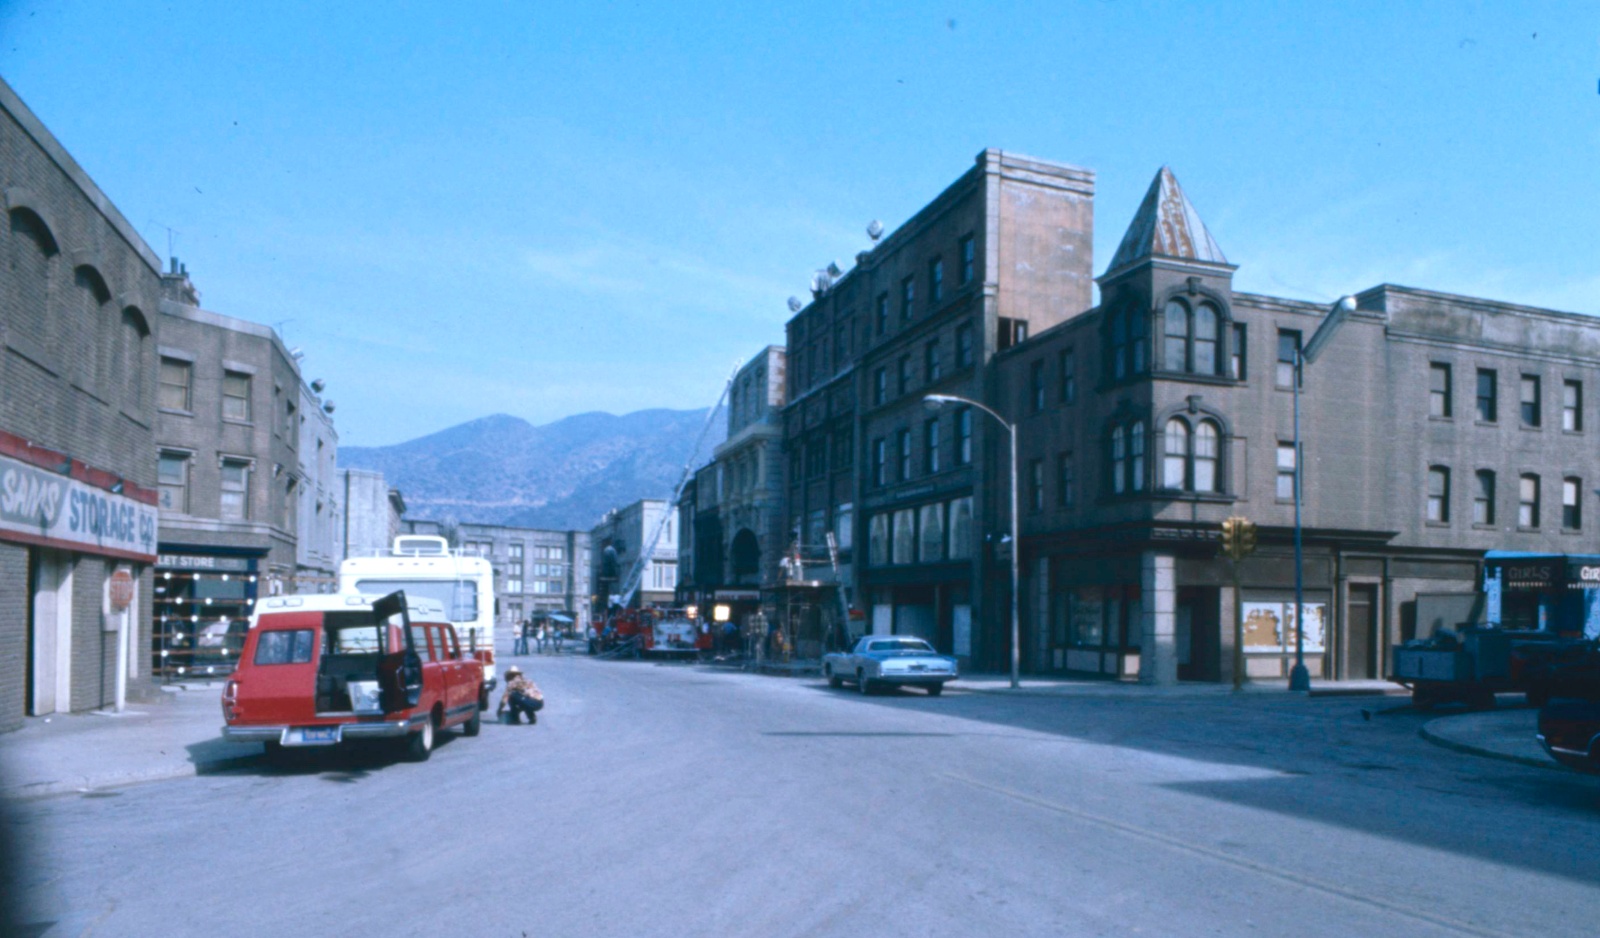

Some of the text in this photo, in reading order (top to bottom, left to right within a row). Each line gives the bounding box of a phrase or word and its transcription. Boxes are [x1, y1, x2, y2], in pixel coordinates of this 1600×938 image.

[69, 487, 135, 543] STORAGE
[156, 555, 178, 565] LET
[180, 556, 214, 567] STORE
[1508, 566, 1551, 580] GIRLS
[1580, 566, 1600, 581] GIR
